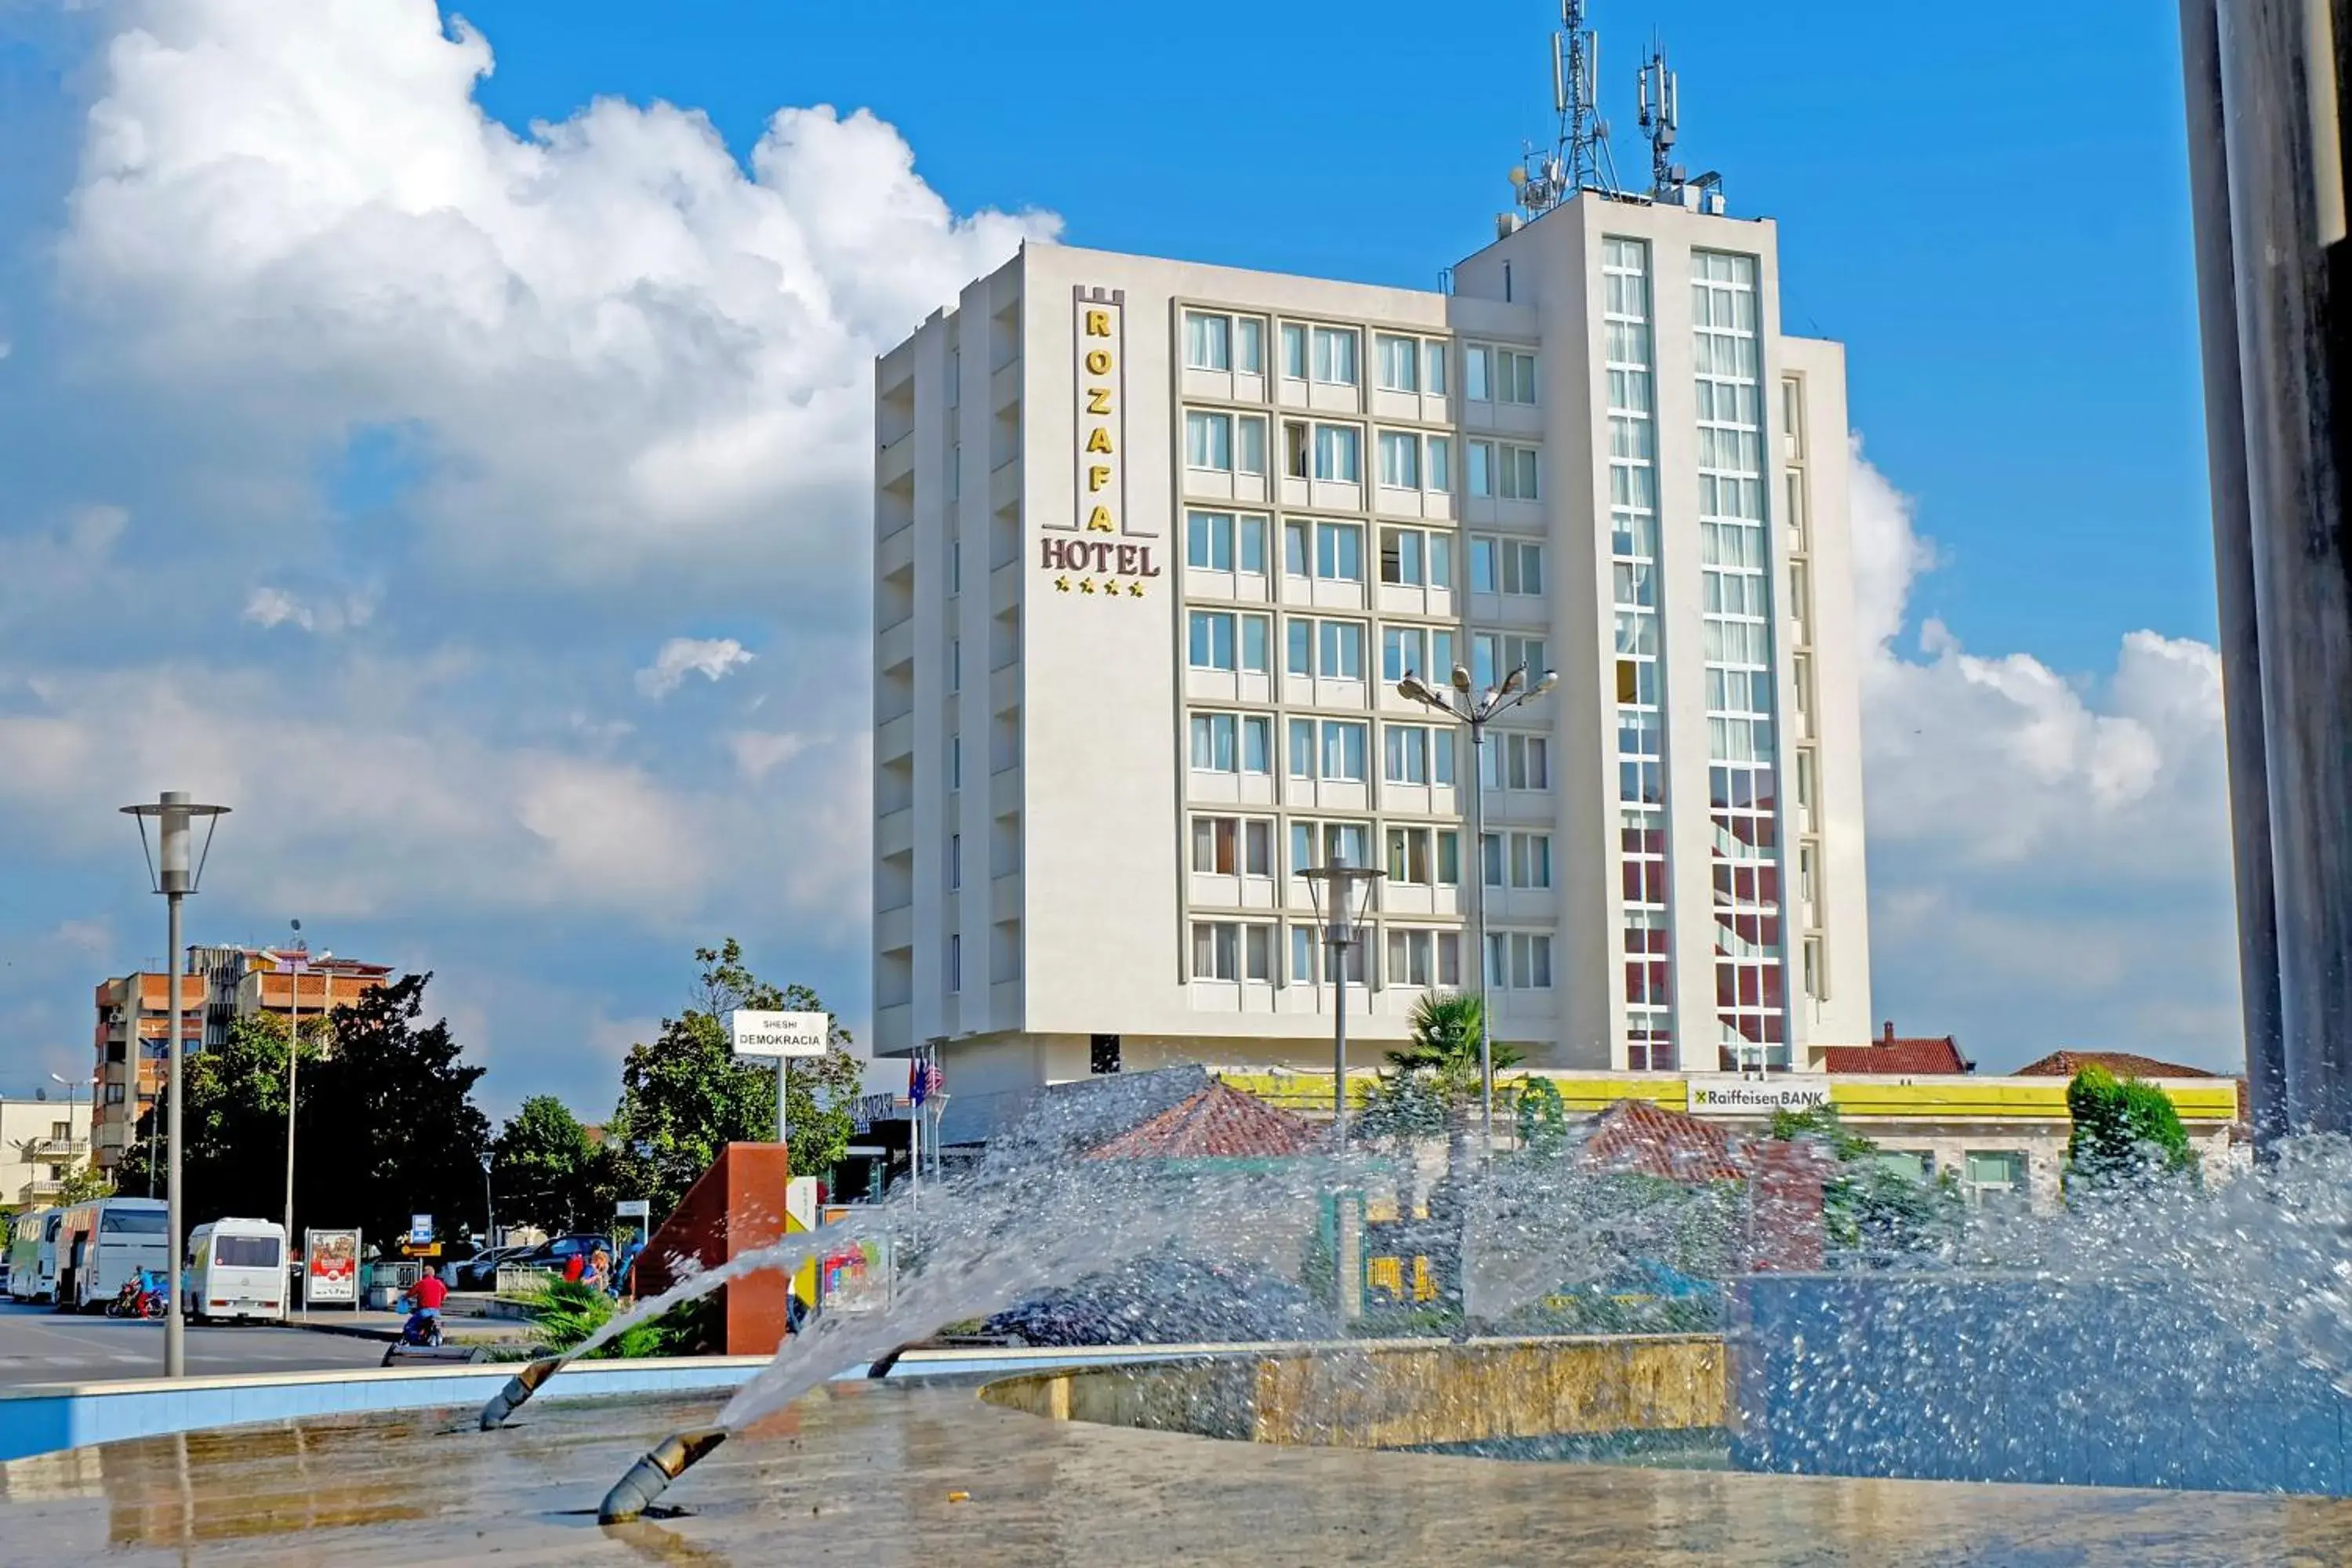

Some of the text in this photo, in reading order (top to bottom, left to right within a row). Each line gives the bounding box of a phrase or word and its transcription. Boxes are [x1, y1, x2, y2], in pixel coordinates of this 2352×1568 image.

[1086, 310, 1112, 532] ROZAFA
[1041, 538, 1160, 577] HOTEL
[739, 1035, 820, 1045] DEMOKRACIA
[1708, 1090, 1824, 1105] Raiffeisen BANK
